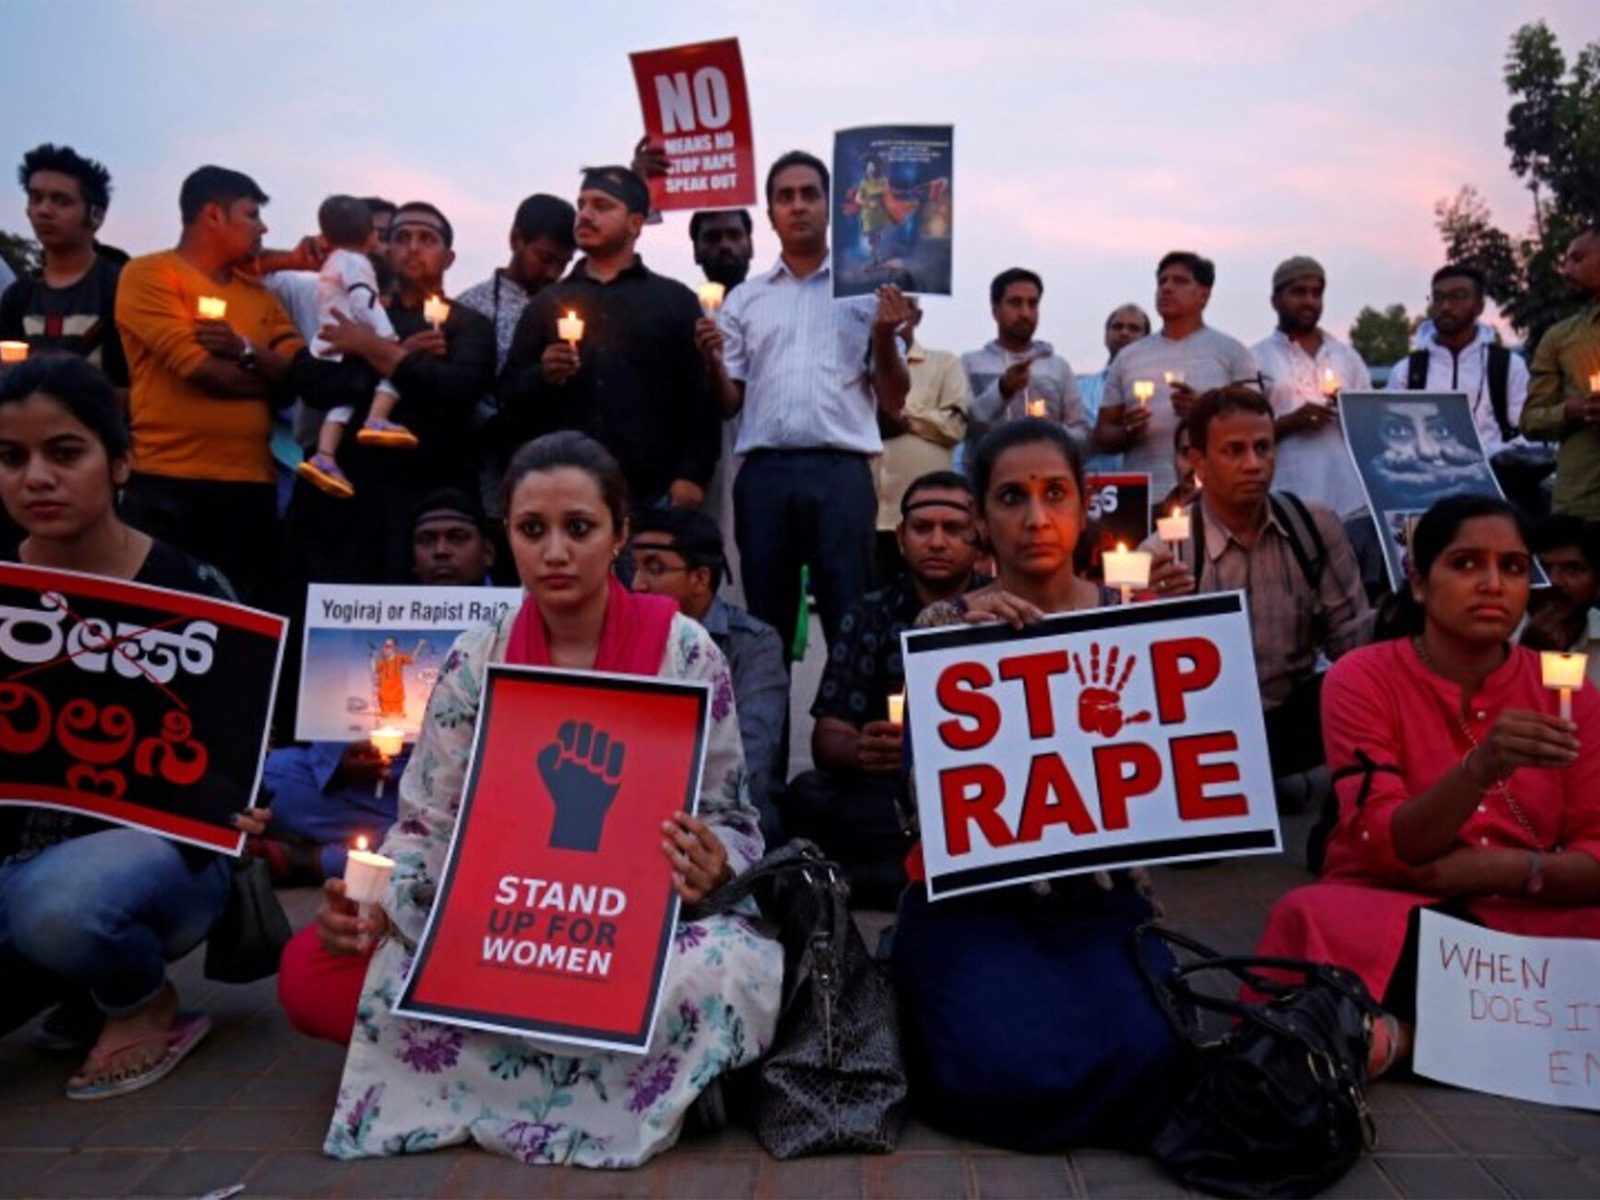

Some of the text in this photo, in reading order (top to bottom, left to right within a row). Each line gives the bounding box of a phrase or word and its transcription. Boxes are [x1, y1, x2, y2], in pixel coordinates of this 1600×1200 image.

[654, 66, 731, 134] NO
[664, 131, 735, 154] MEANS NO
[702, 153, 736, 171] RAPE
[665, 174, 737, 194] SPEAK OUT
[321, 599, 382, 624] Yogiraj
[387, 606, 407, 622] or
[410, 601, 464, 624] Rapist
[938, 730, 1250, 857] RAPE
[495, 875, 627, 917] STAND
[487, 909, 618, 948] UP FOR
[481, 936, 612, 976] WOMEN
[1439, 936, 1550, 991] WHEN
[1470, 989, 1553, 1028] DOES
